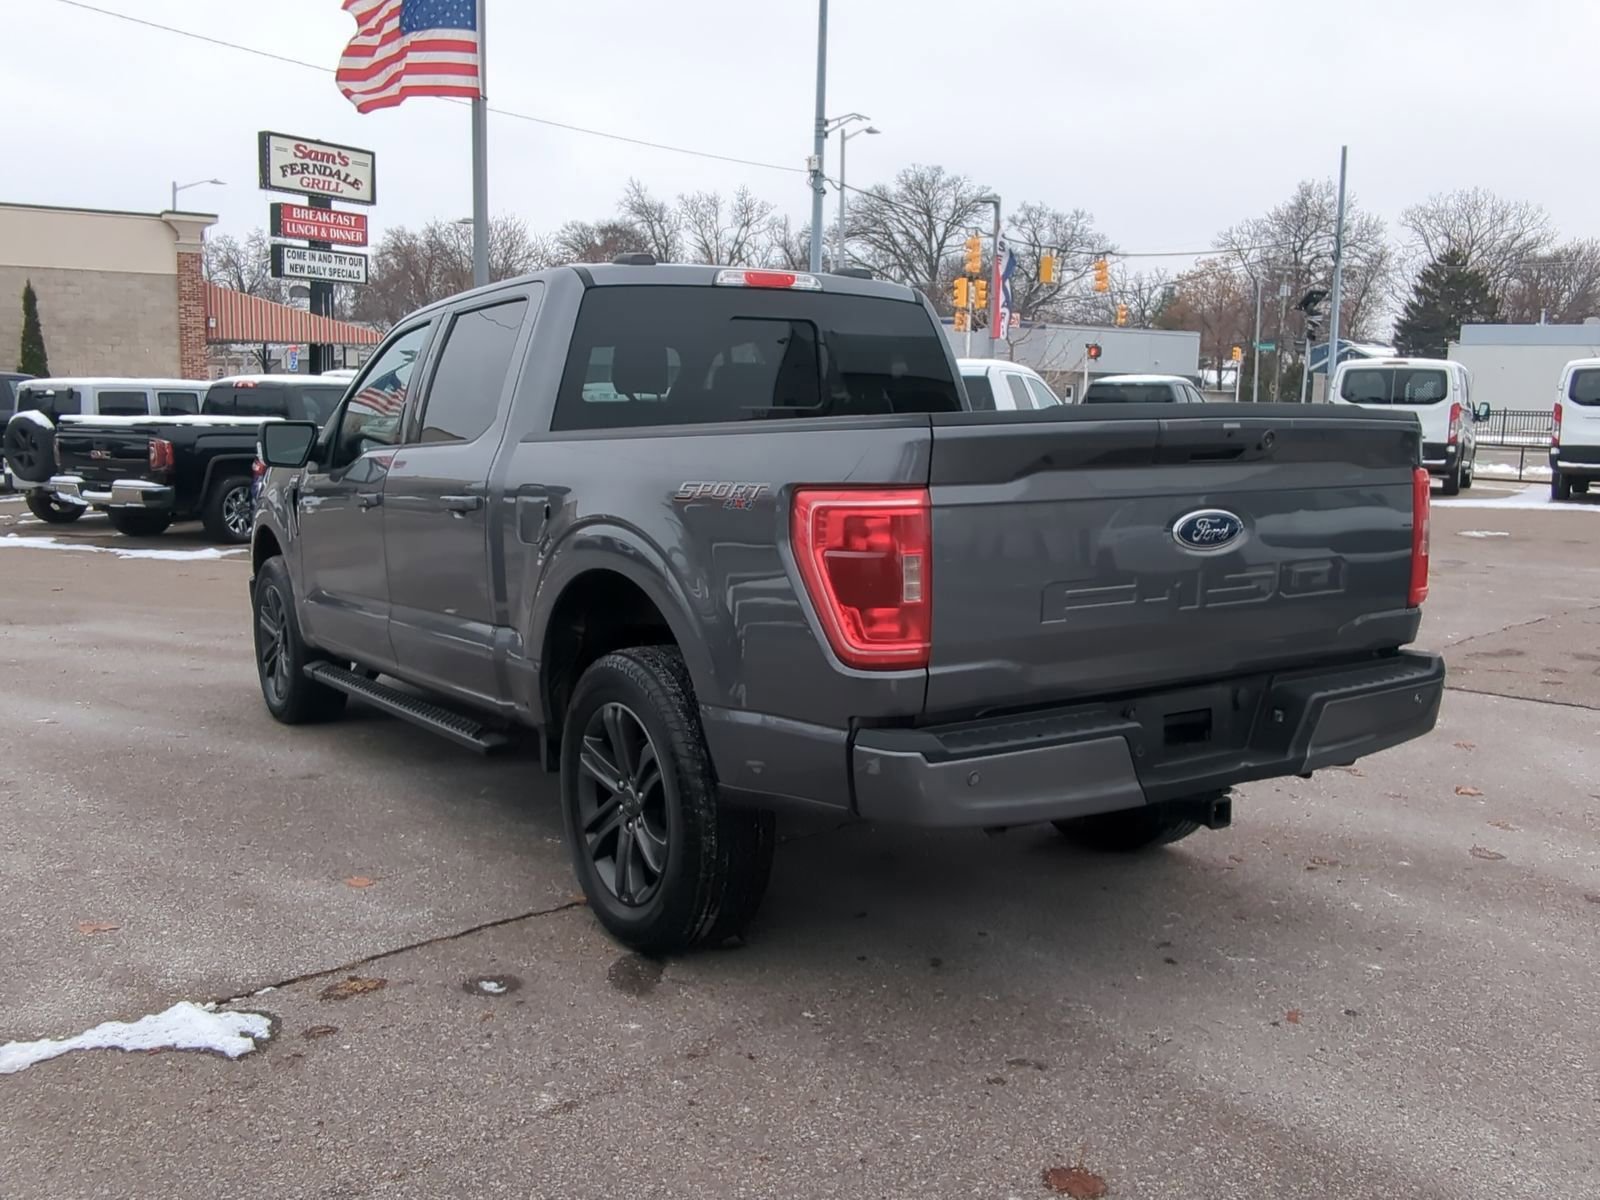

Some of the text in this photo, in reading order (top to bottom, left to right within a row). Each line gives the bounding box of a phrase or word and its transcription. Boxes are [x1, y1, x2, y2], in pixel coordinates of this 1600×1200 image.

[293, 143, 350, 167] Sam's
[280, 163, 363, 190] FERNDALE
[300, 176, 344, 193] GRILL
[292, 207, 357, 226] BREAKFAST
[286, 222, 363, 242] LUNCH & DINNER
[286, 249, 363, 267] COME IN AND TRY OUR
[289, 263, 360, 279] NEW DAILY SPECIALS
[673, 481, 770, 501] SPORT
[1191, 517, 1231, 542] Ford
[1040, 556, 1348, 624] F-150
